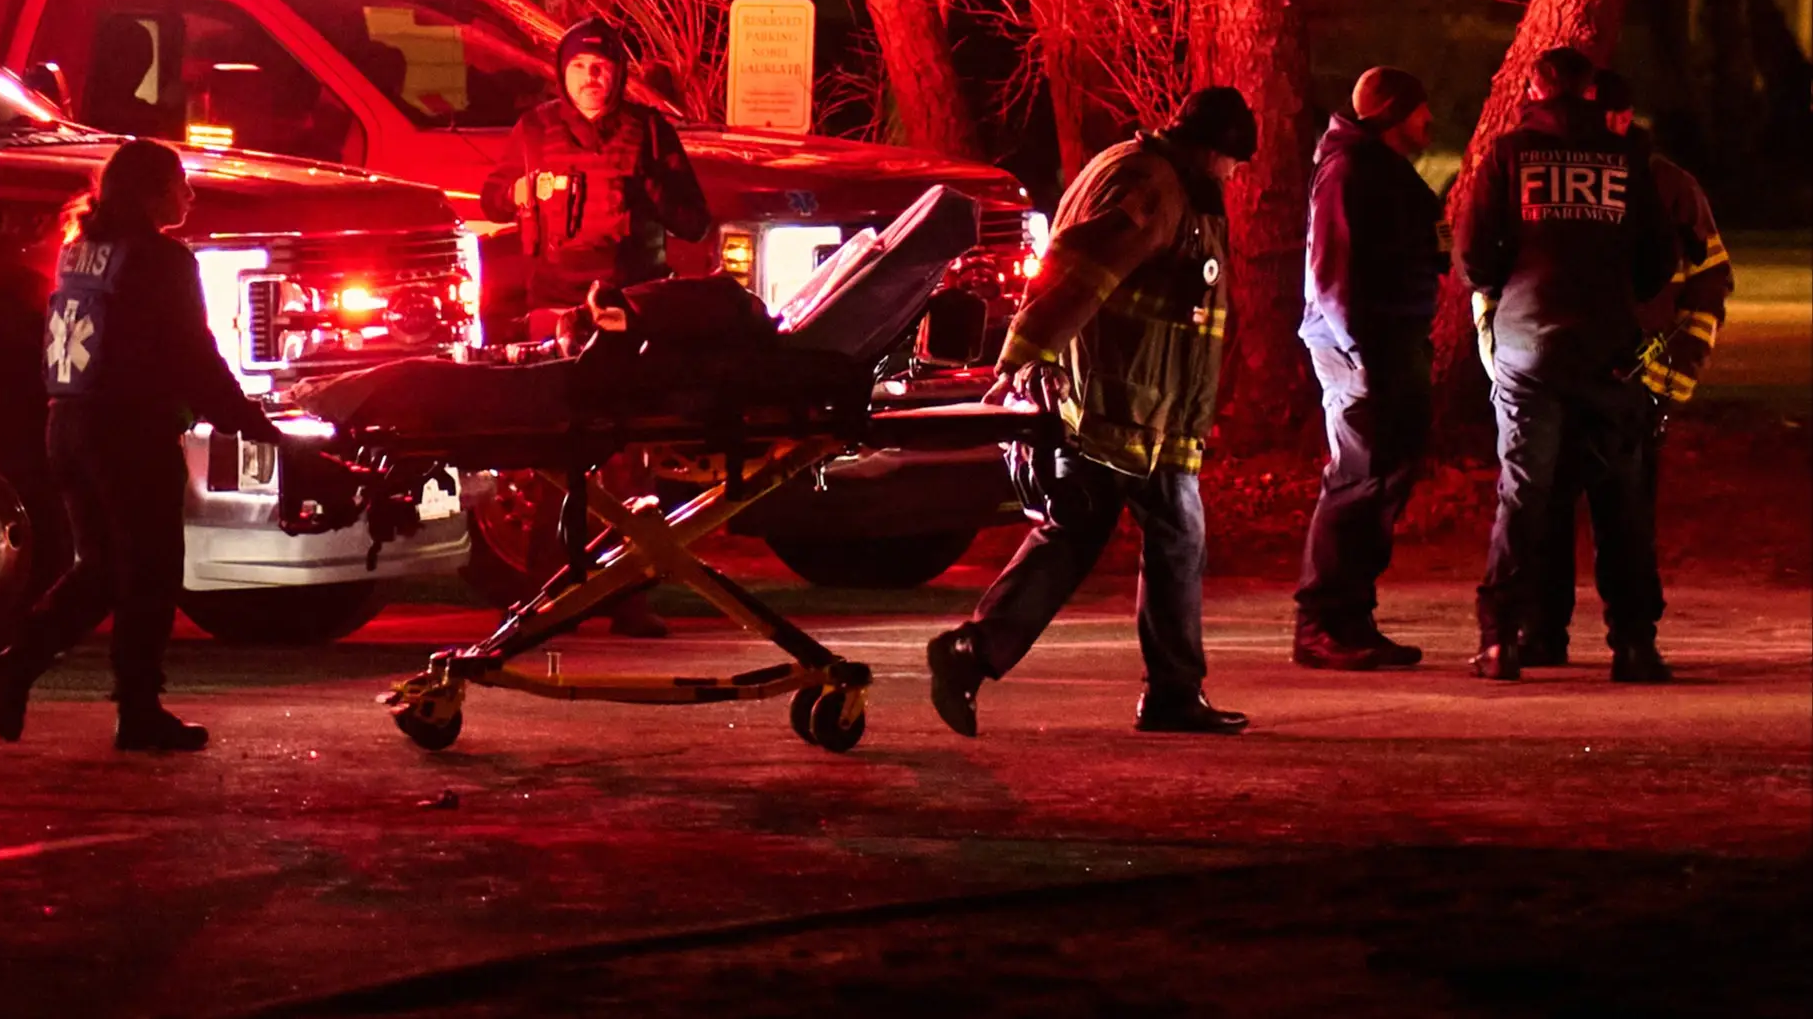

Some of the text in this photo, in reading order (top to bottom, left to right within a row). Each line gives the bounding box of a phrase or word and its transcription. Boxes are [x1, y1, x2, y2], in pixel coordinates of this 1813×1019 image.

[1519, 149, 1626, 167] PROVIDENCE
[1520, 166, 1628, 209] FIRE
[1521, 206, 1625, 225] DEPARTMENT
[60, 242, 112, 277] EMS
